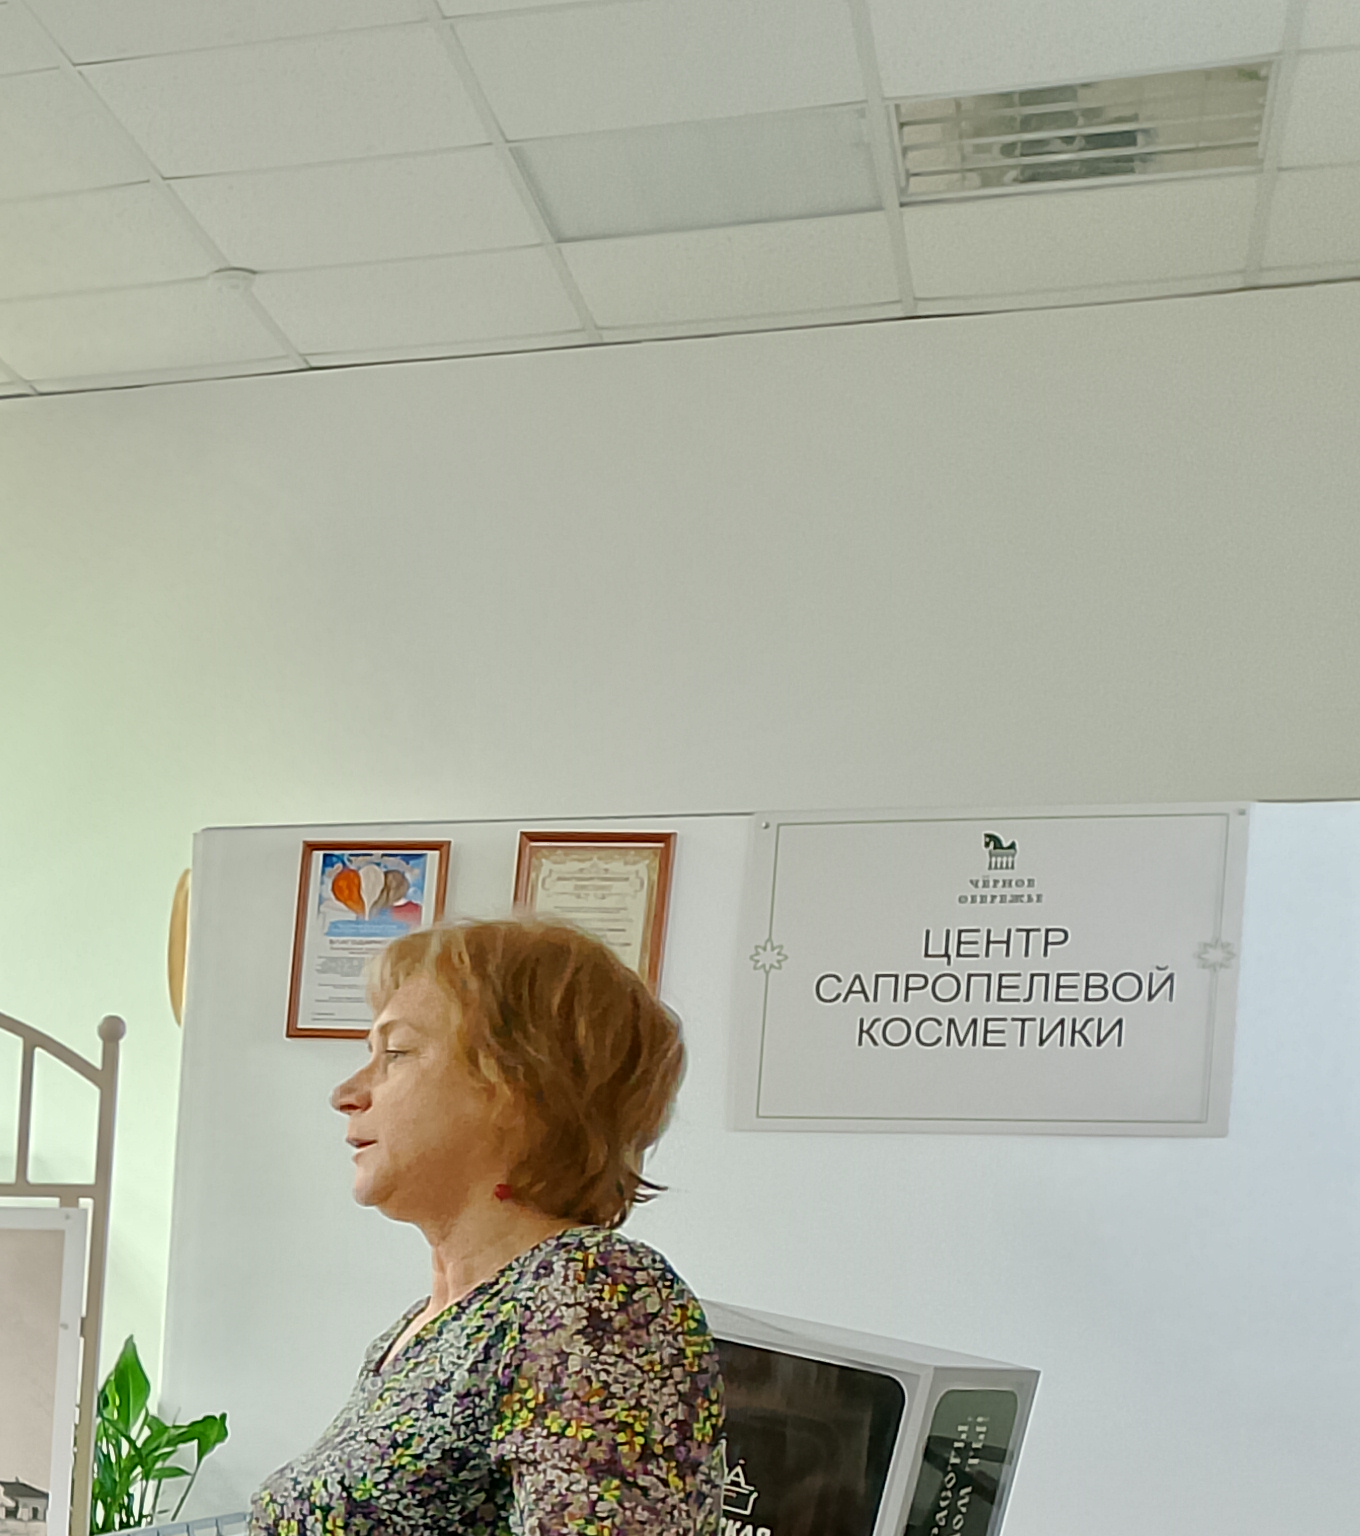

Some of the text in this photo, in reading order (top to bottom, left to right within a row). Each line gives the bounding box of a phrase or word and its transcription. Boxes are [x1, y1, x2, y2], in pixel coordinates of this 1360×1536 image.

[923, 927, 1070, 965] ЦЕНТР
[814, 965, 1176, 1004] САПРОПЕЛЕВОЙ
[856, 1016, 1125, 1048] КОСМЕТИКИ
